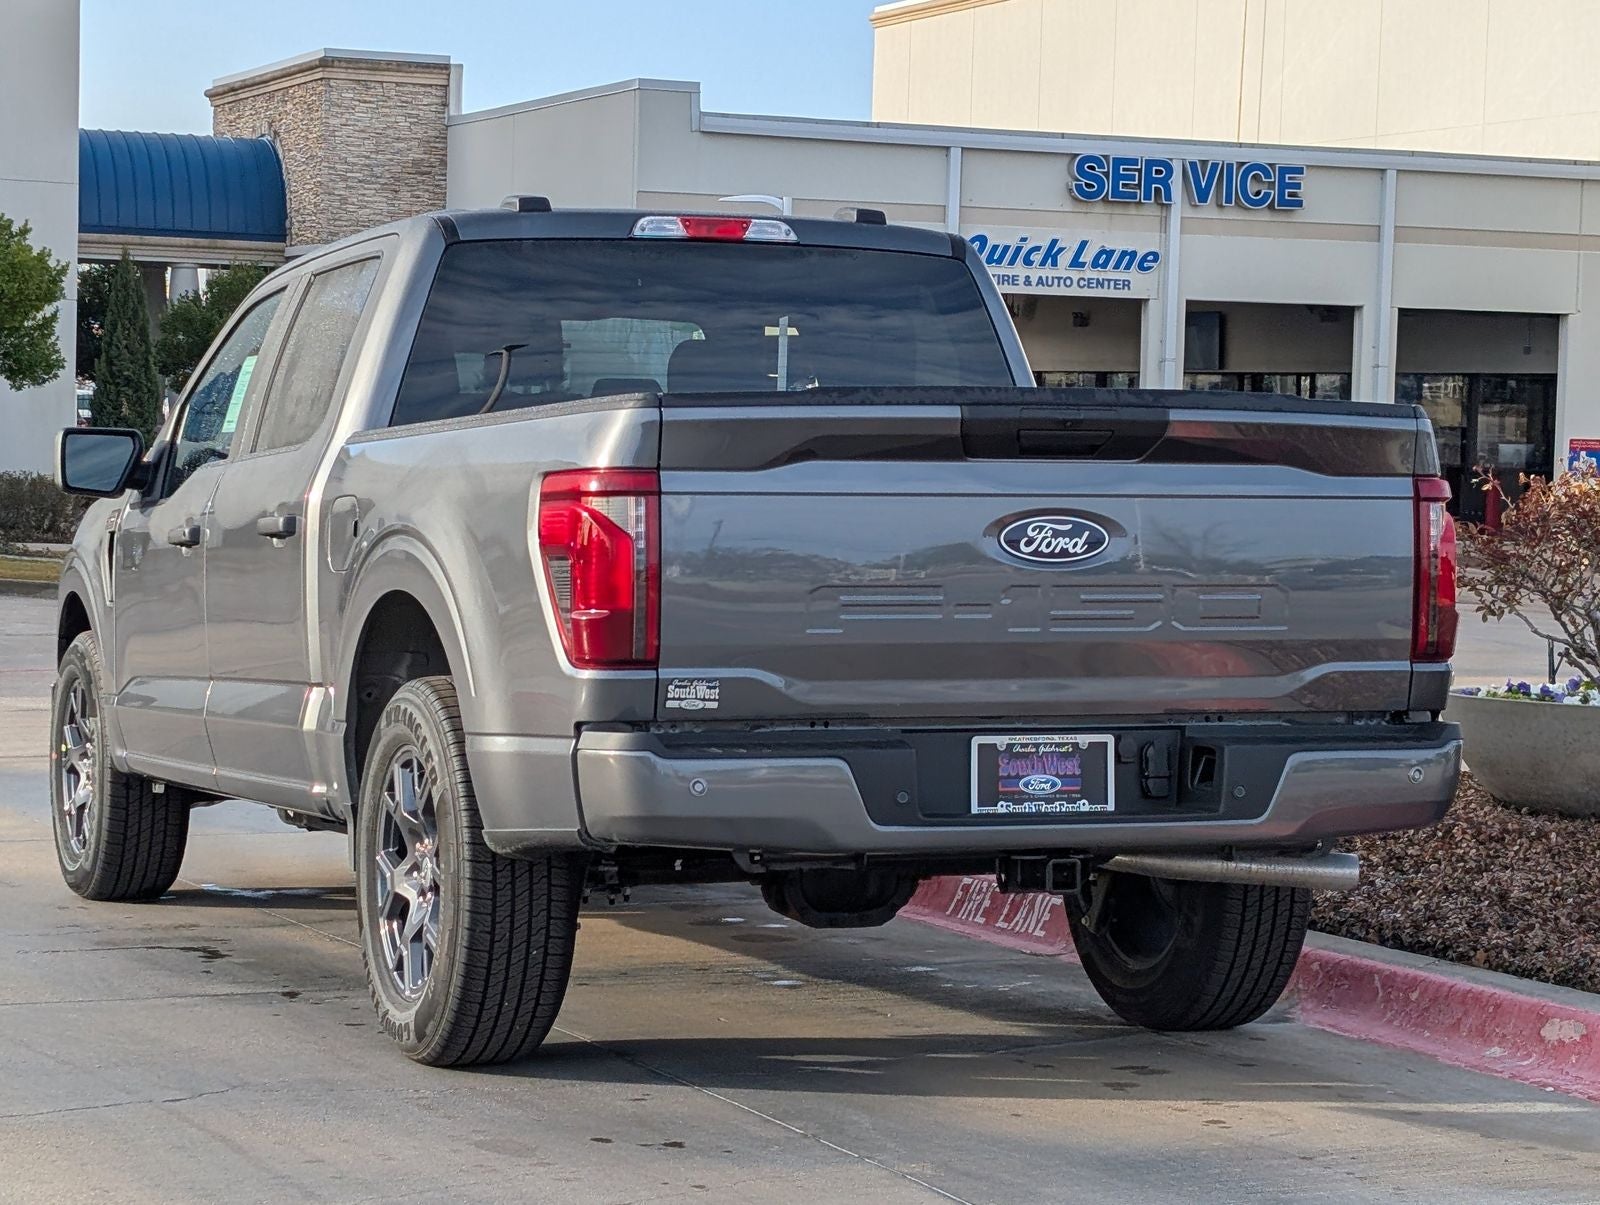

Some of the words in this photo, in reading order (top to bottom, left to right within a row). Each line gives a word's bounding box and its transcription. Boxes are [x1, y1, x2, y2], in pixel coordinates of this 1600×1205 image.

[1072, 153, 1306, 210] SERVICE
[967, 234, 1069, 269] Quick
[1067, 238, 1161, 274] Lane
[1023, 274, 1033, 287] &
[1035, 275, 1073, 289] AUTO
[1076, 277, 1132, 291] CENTER
[1019, 515, 1091, 555] Ford
[667, 685, 720, 700] SouthWest
[385, 704, 439, 787] WRANGLER
[1012, 744, 1037, 753] Charlie
[999, 753, 1082, 776] SouthWest
[1028, 778, 1052, 791] Ford
[946, 877, 1000, 925] FIRE
[995, 892, 1063, 937] LANE
